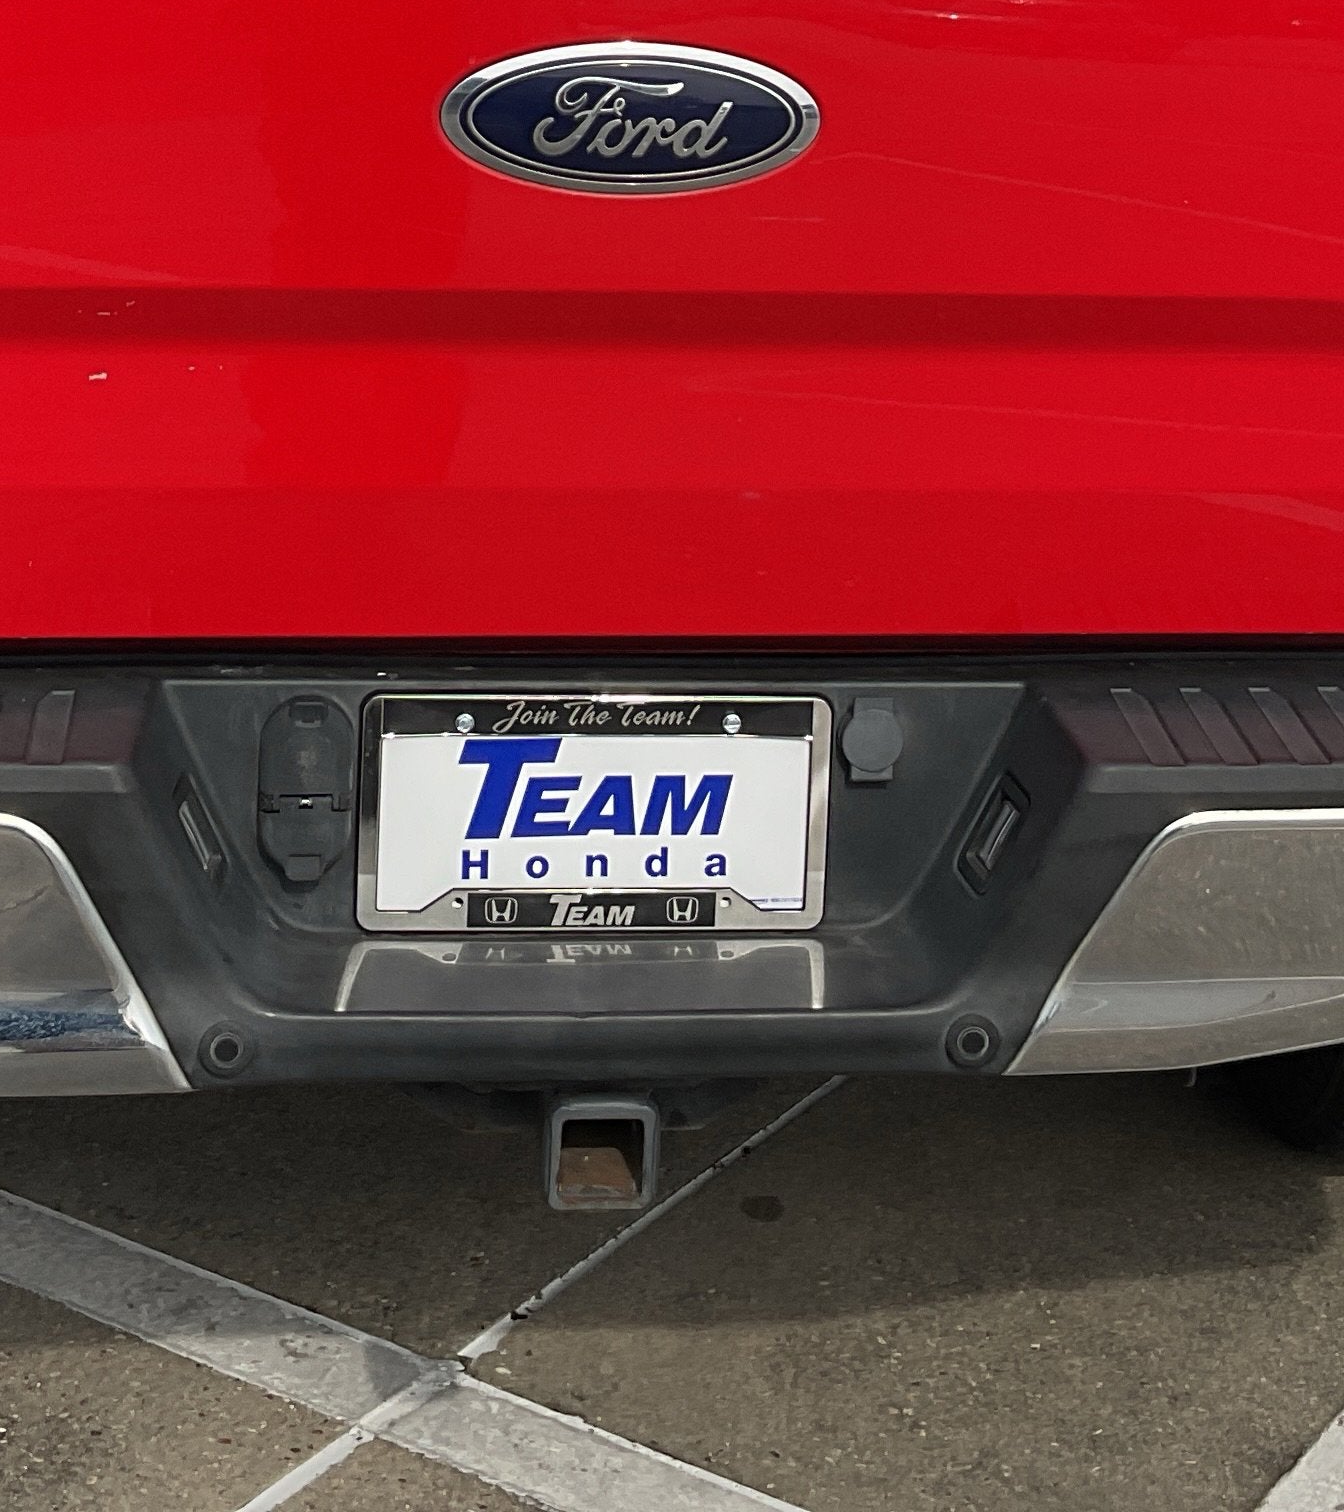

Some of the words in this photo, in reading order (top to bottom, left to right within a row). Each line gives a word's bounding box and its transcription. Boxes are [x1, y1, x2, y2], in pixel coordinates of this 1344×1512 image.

[532, 75, 734, 159] Ford
[492, 700, 559, 734] Join
[564, 701, 612, 728] The
[618, 702, 702, 728] Team!
[458, 737, 734, 839] TEAM
[460, 846, 728, 880] Honda
[549, 894, 635, 926] TEAM
